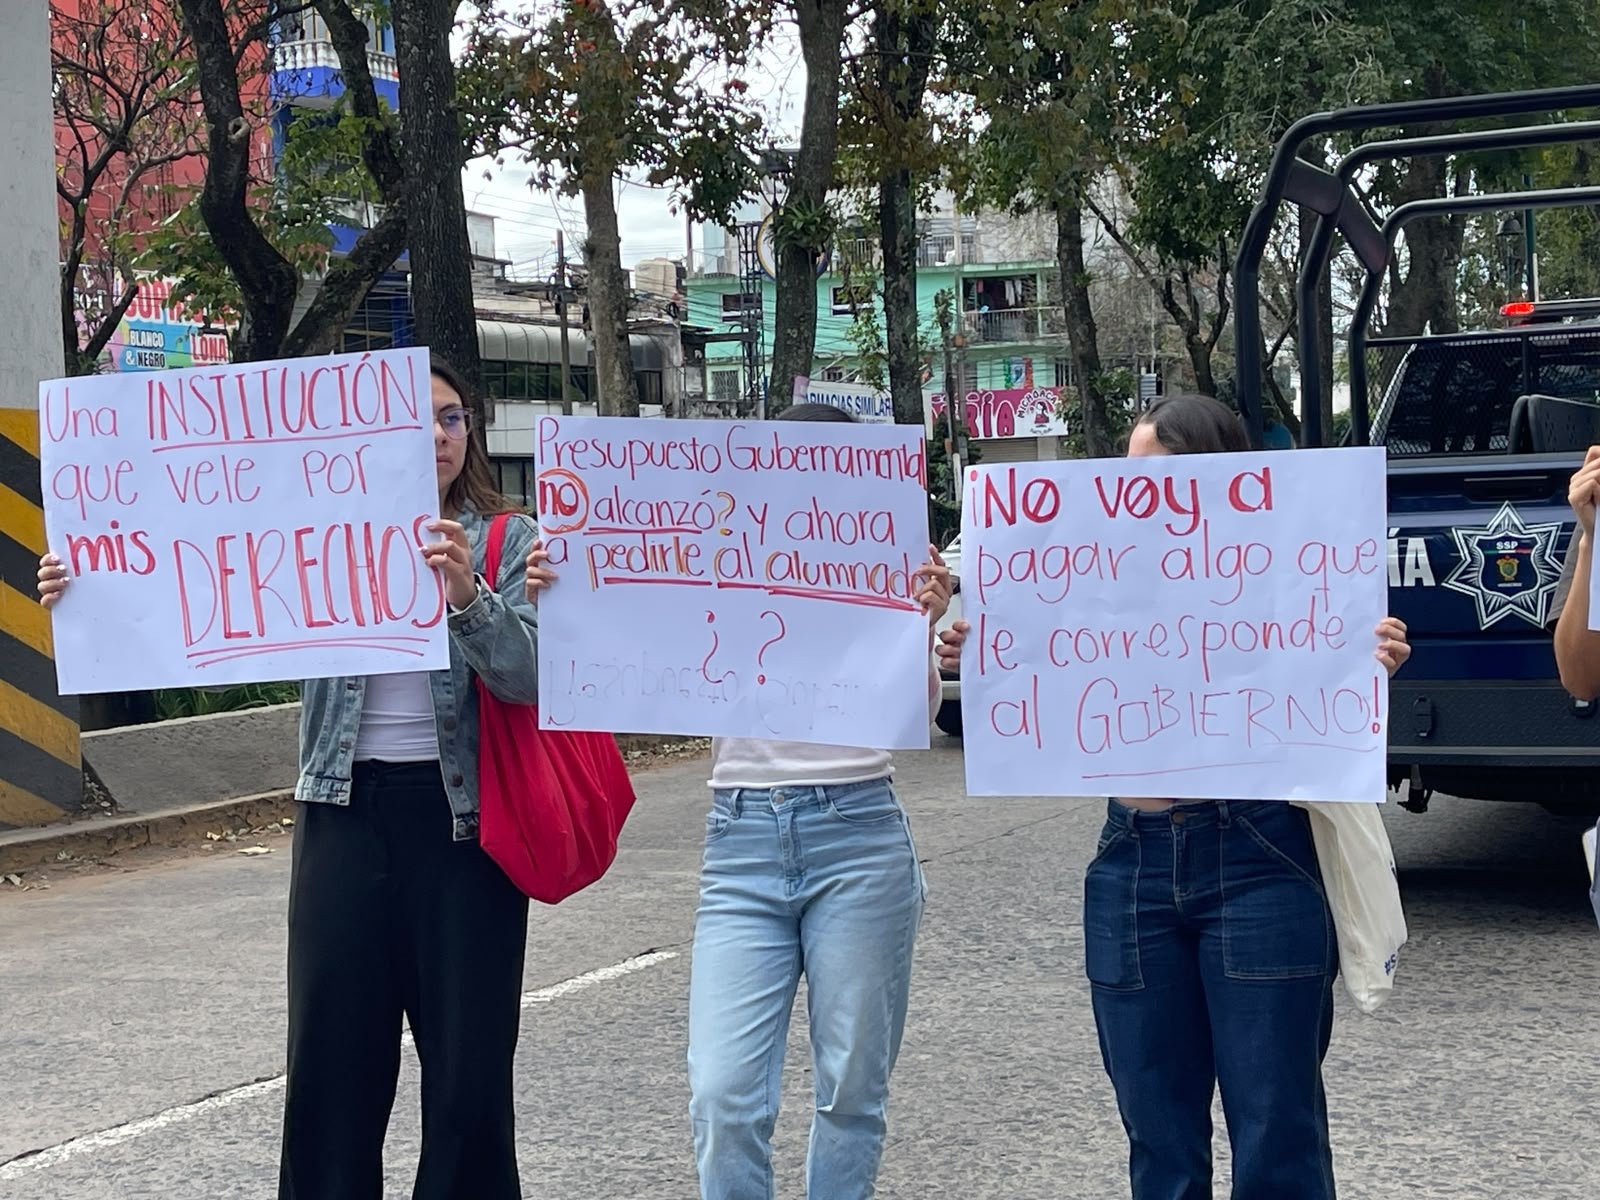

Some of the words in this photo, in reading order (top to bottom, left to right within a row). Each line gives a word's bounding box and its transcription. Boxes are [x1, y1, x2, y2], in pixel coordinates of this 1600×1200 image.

[125, 351, 135, 365] &
[137, 352, 165, 368] NEGRO
[129, 329, 164, 347] BLANCO
[192, 334, 227, 362] LONA
[47, 387, 119, 442] Una
[147, 352, 418, 440] INSTITUCIÓN
[806, 393, 852, 414] RMACIAS
[52, 459, 138, 521] que
[166, 455, 260, 504] vele
[302, 445, 371, 497] por
[538, 417, 721, 480] Presupuesto
[726, 424, 927, 490] Gubernamental
[538, 477, 579, 518] no
[594, 484, 736, 536] alcanzó?
[747, 502, 768, 545] y
[785, 497, 895, 546] ahora
[1094, 475, 1200, 536] voy
[1228, 466, 1273, 512] a
[66, 520, 156, 577] mis
[173, 514, 444, 646] DERECHOS
[545, 536, 569, 565] a
[586, 532, 705, 592] pedirle
[715, 533, 752, 583] al
[977, 542, 1136, 605] pagar
[1161, 518, 1272, 606] algo
[1297, 538, 1378, 612] que
[1496, 540, 1518, 550] SSP
[757, 610, 786, 686] ?
[979, 613, 1018, 675] le
[1049, 595, 1346, 683] corresponde
[990, 674, 1041, 750] al
[1076, 675, 1381, 754] GOBIERNO!
